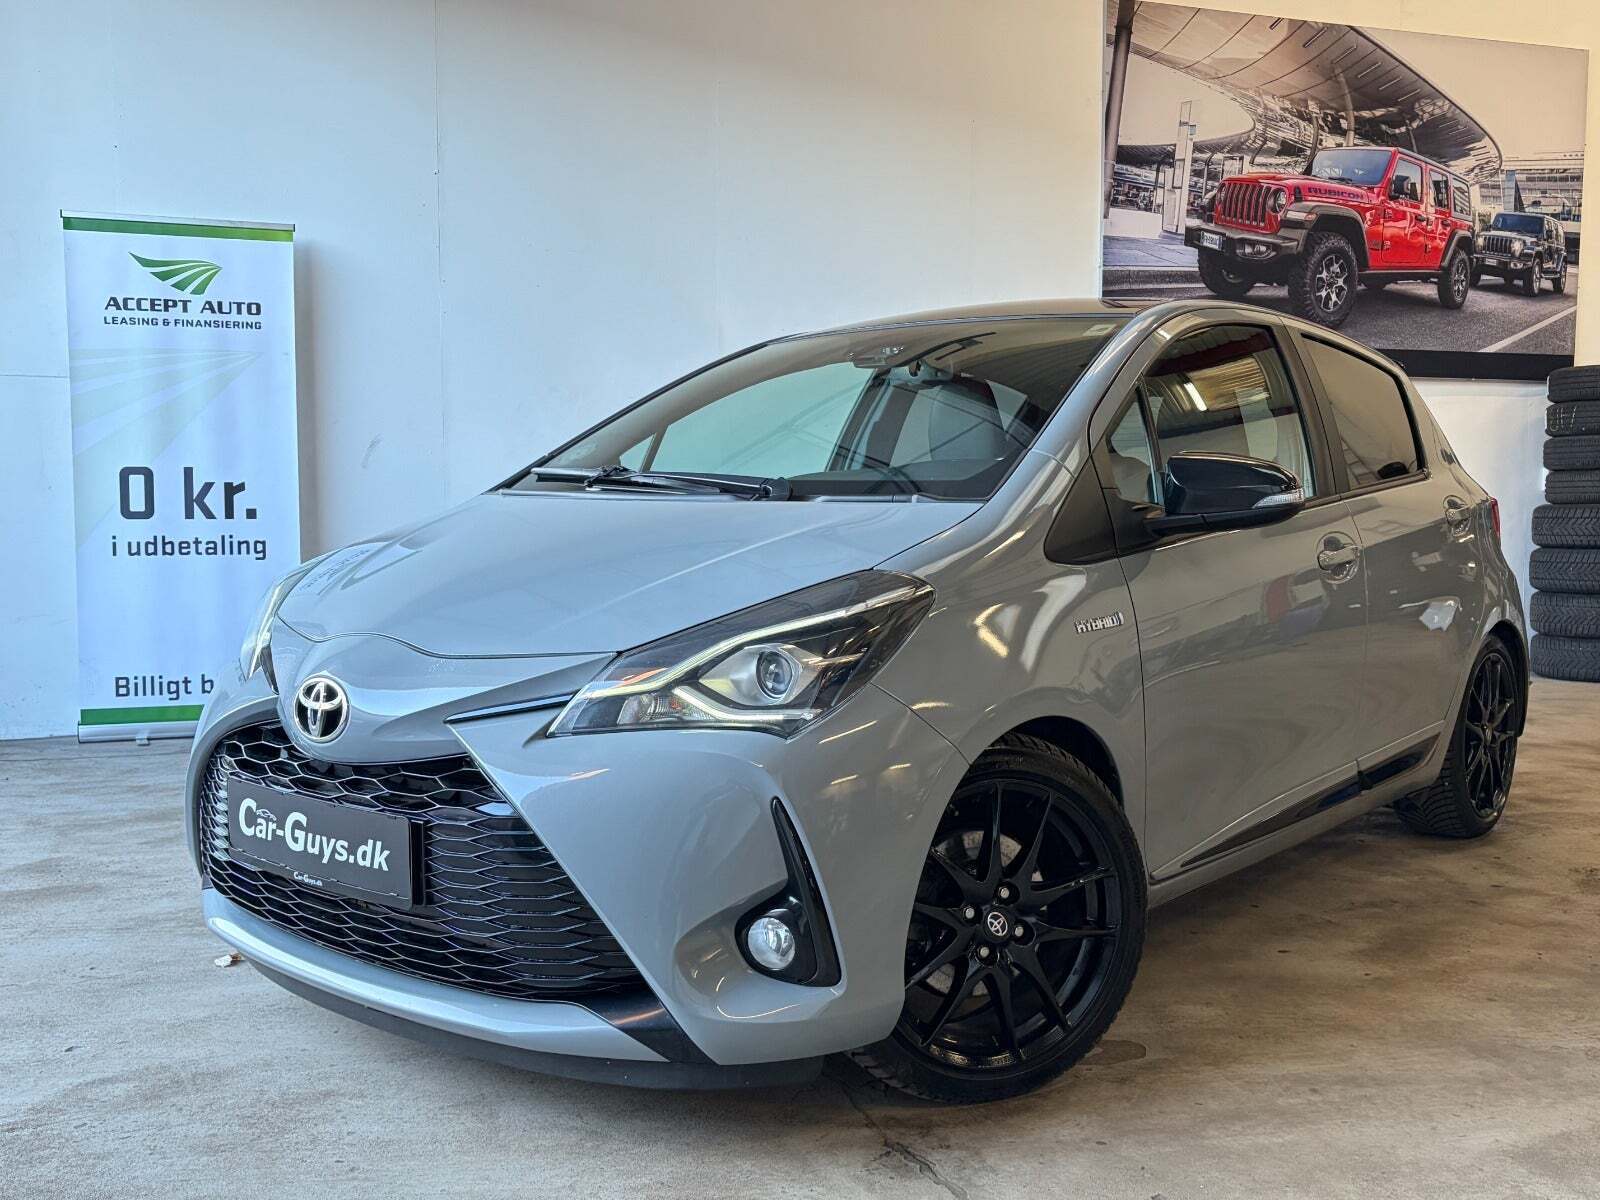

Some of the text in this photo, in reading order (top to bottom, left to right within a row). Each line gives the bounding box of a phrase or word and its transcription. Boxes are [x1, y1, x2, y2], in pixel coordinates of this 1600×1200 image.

[1307, 186, 1364, 200] RUBICON
[104, 296, 262, 316] ACCEPT AUTO
[103, 315, 262, 330] LEASING & FINANSIERING
[183, 466, 258, 520] kr.
[111, 534, 267, 561] i udbetaling
[1075, 611, 1122, 634] HYBRID
[114, 675, 193, 700] Billigt
[238, 798, 391, 872] Car-Guys.dk
